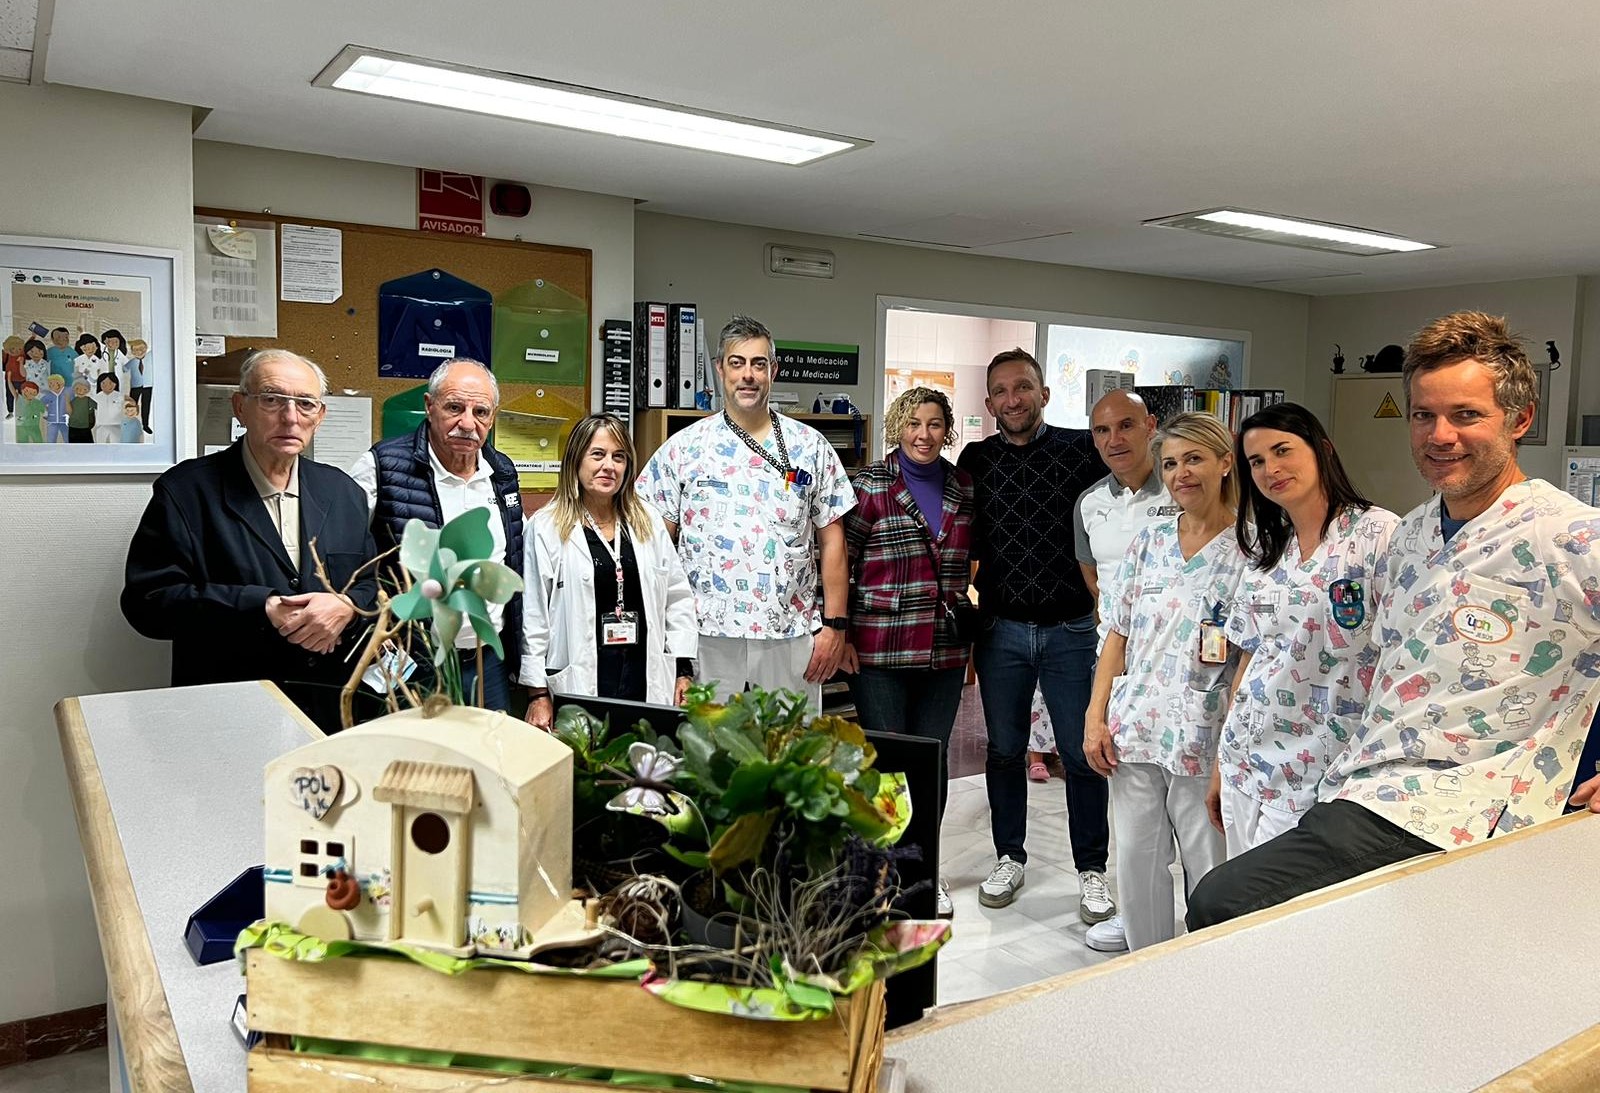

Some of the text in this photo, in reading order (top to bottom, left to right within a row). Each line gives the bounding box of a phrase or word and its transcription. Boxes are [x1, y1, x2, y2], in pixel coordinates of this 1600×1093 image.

[422, 220, 480, 235] AVISADOR
[65, 301, 94, 309] ¡GRACIAS!
[784, 355, 794, 363] de
[797, 355, 804, 364] la
[807, 356, 849, 366] Medicación
[780, 369, 840, 380] de la Medicació
[295, 774, 331, 795] POL
